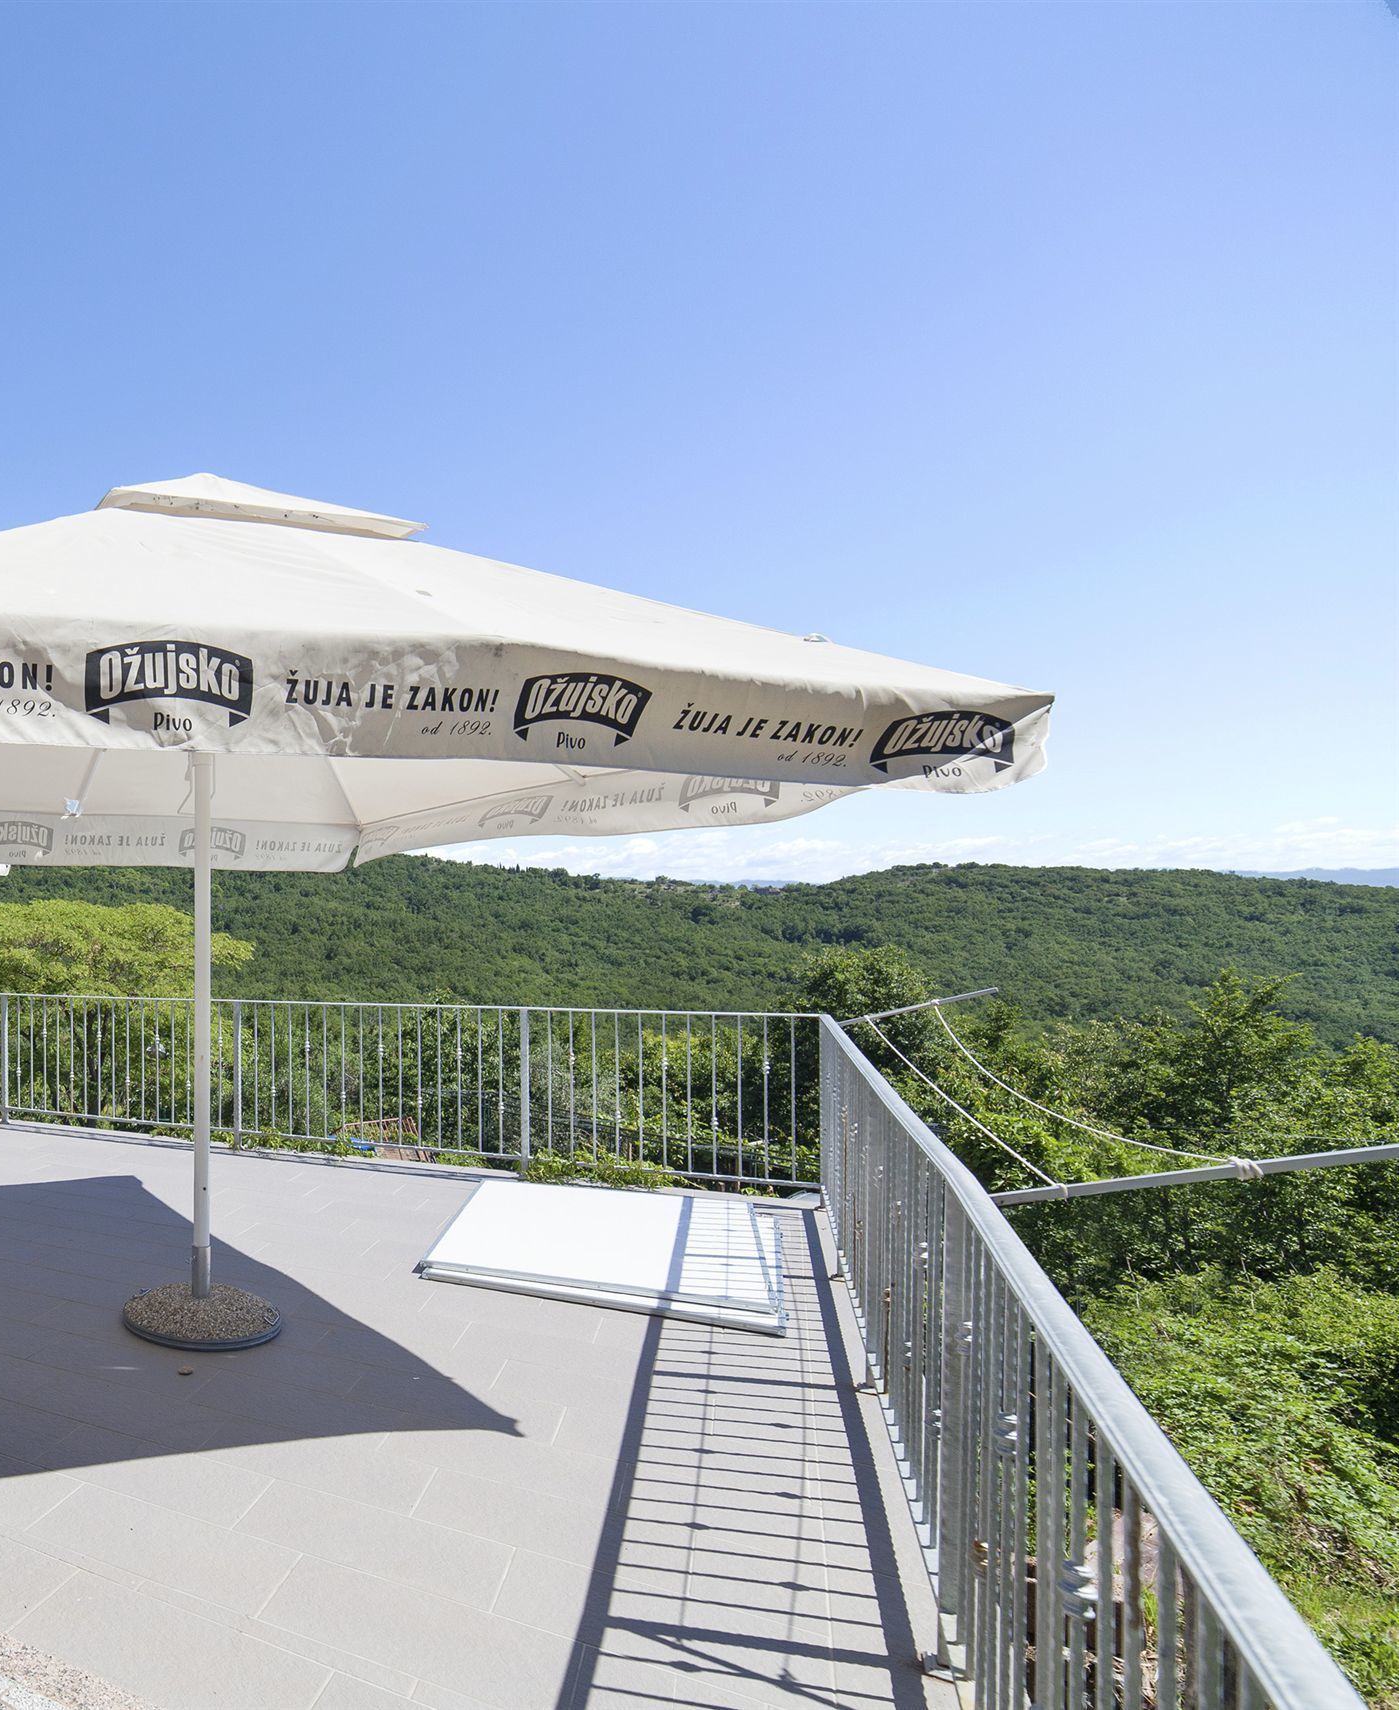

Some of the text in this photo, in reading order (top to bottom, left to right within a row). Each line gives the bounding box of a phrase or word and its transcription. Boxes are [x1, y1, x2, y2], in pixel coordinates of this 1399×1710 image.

[99, 643, 240, 701] Ožujsko
[285, 669, 500, 713] ŽUJA JE ZAKON!
[524, 675, 640, 725] Ožujsko
[153, 711, 193, 732] Pivo
[421, 720, 492, 737] od 1892.
[673, 702, 864, 748] ŽUJA JE ZAKON!
[883, 713, 1003, 755] Ožujsko
[556, 731, 587, 750] Pivo
[777, 751, 847, 768] od 1892.
[922, 765, 962, 778] Pivo
